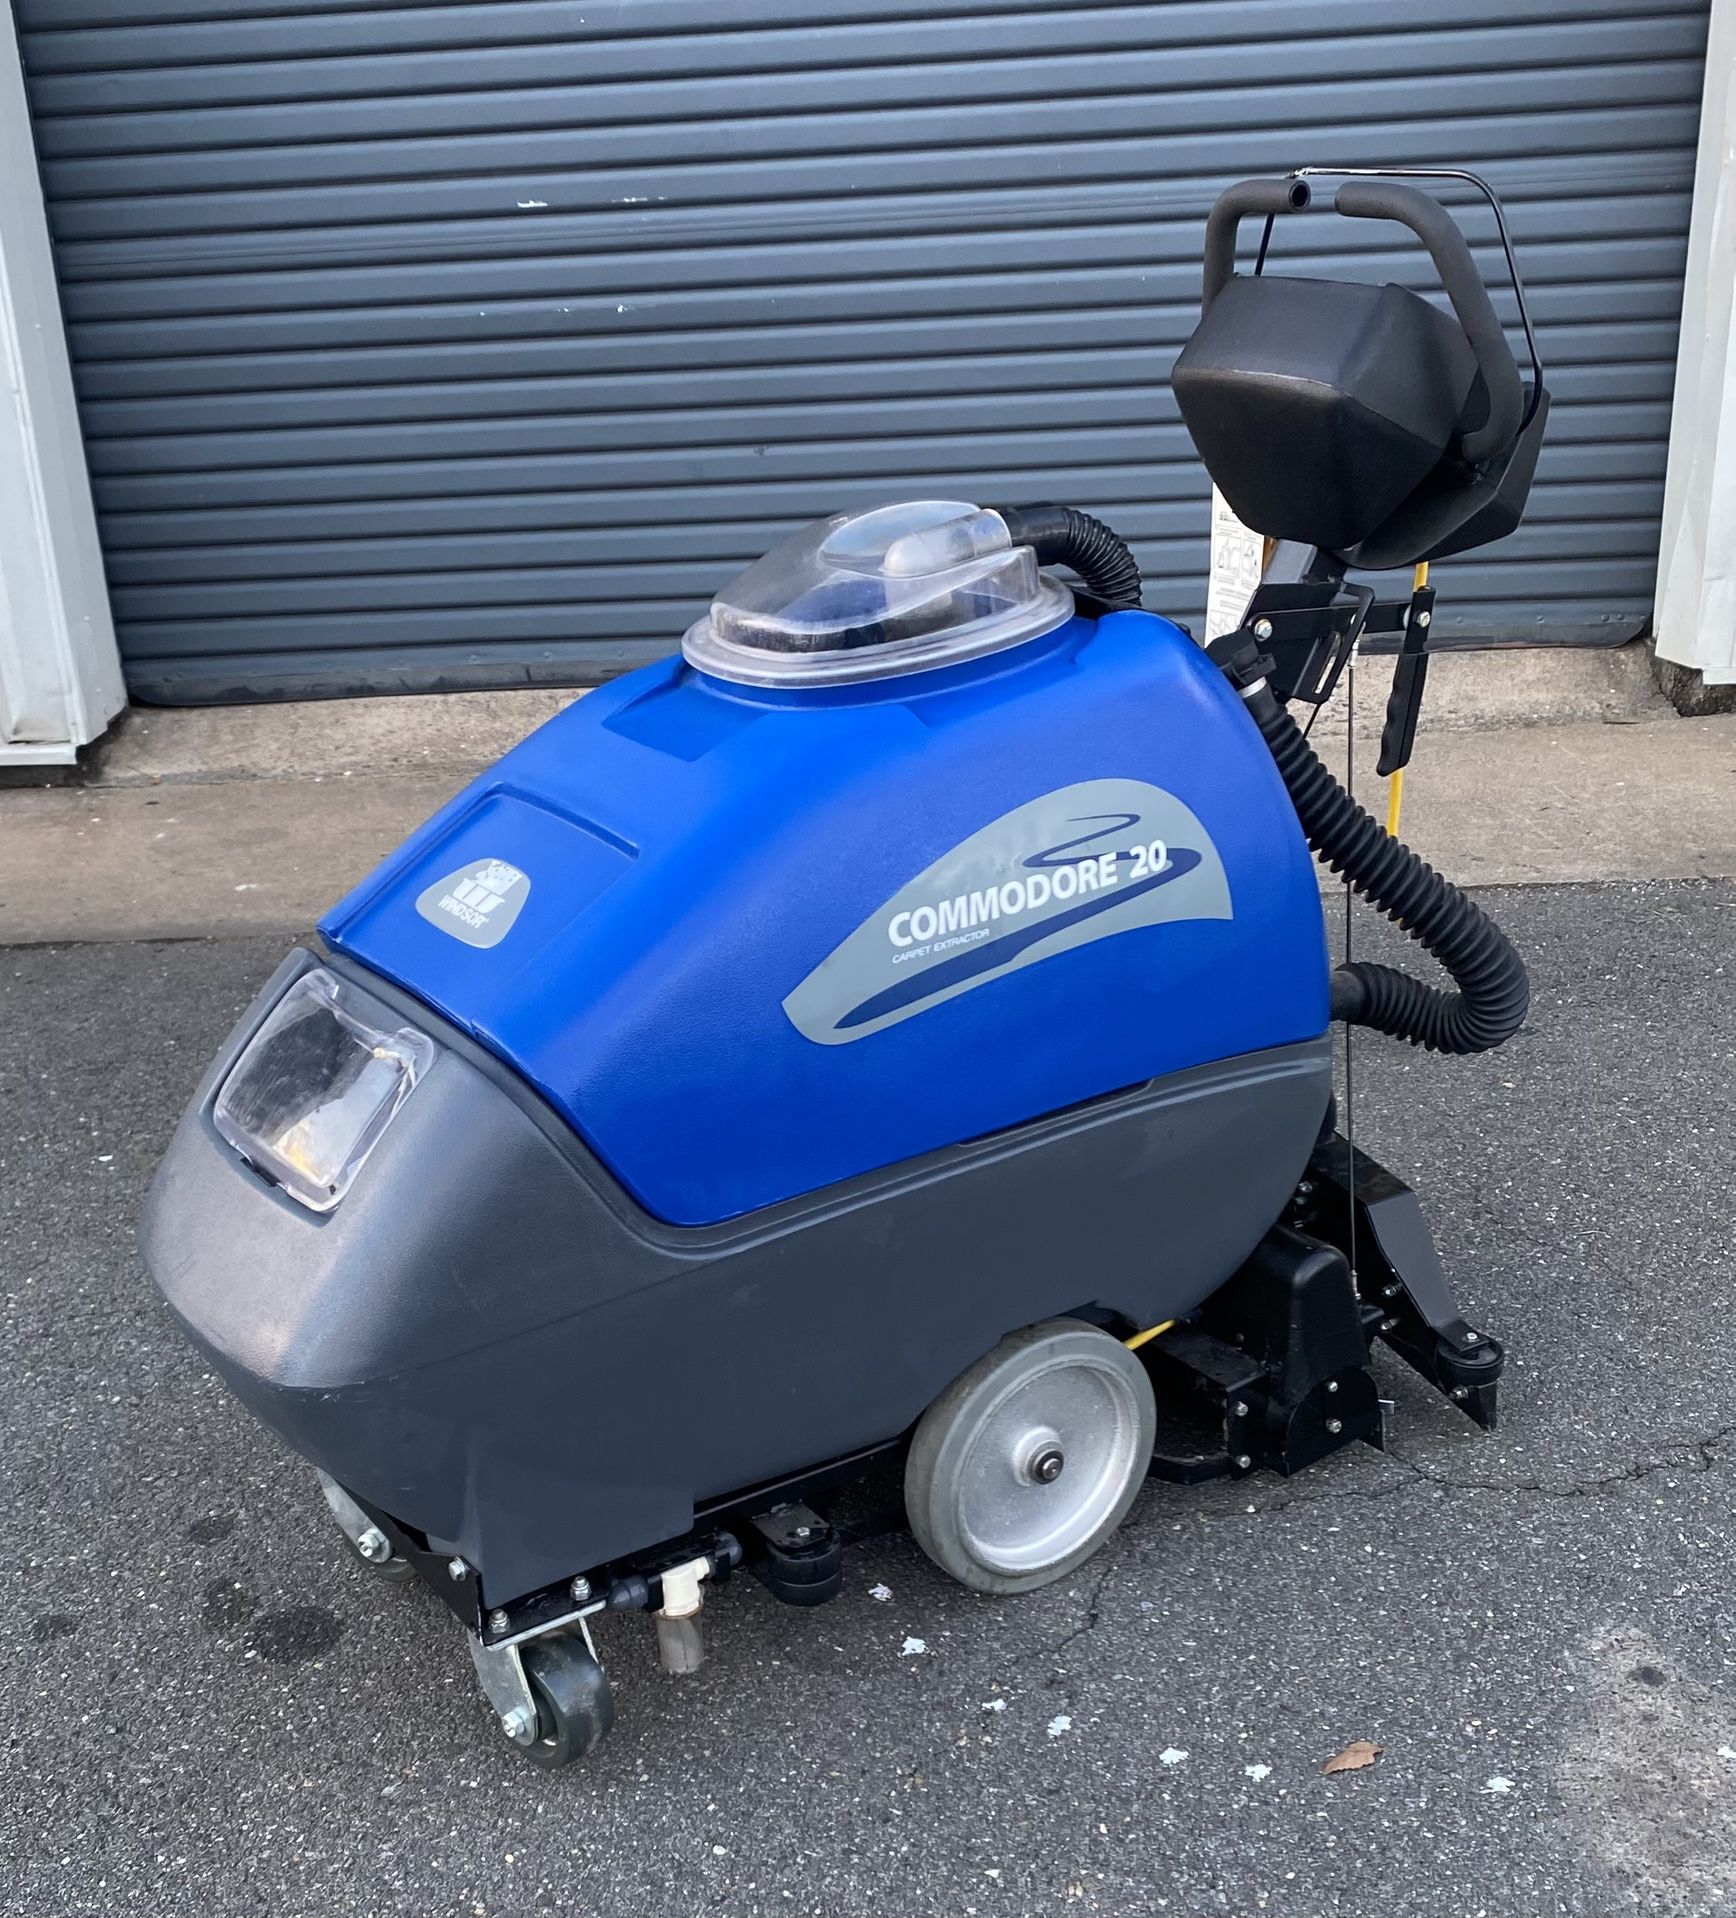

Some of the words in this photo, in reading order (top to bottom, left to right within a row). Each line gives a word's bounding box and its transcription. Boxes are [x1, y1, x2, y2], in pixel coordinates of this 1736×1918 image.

[888, 852, 1118, 947] COMMODORE
[1129, 839, 1168, 879] 20
[438, 894, 487, 929] WINDSOR
[892, 945, 931, 964] CARPET
[933, 928, 990, 952] EXTRACTOR
